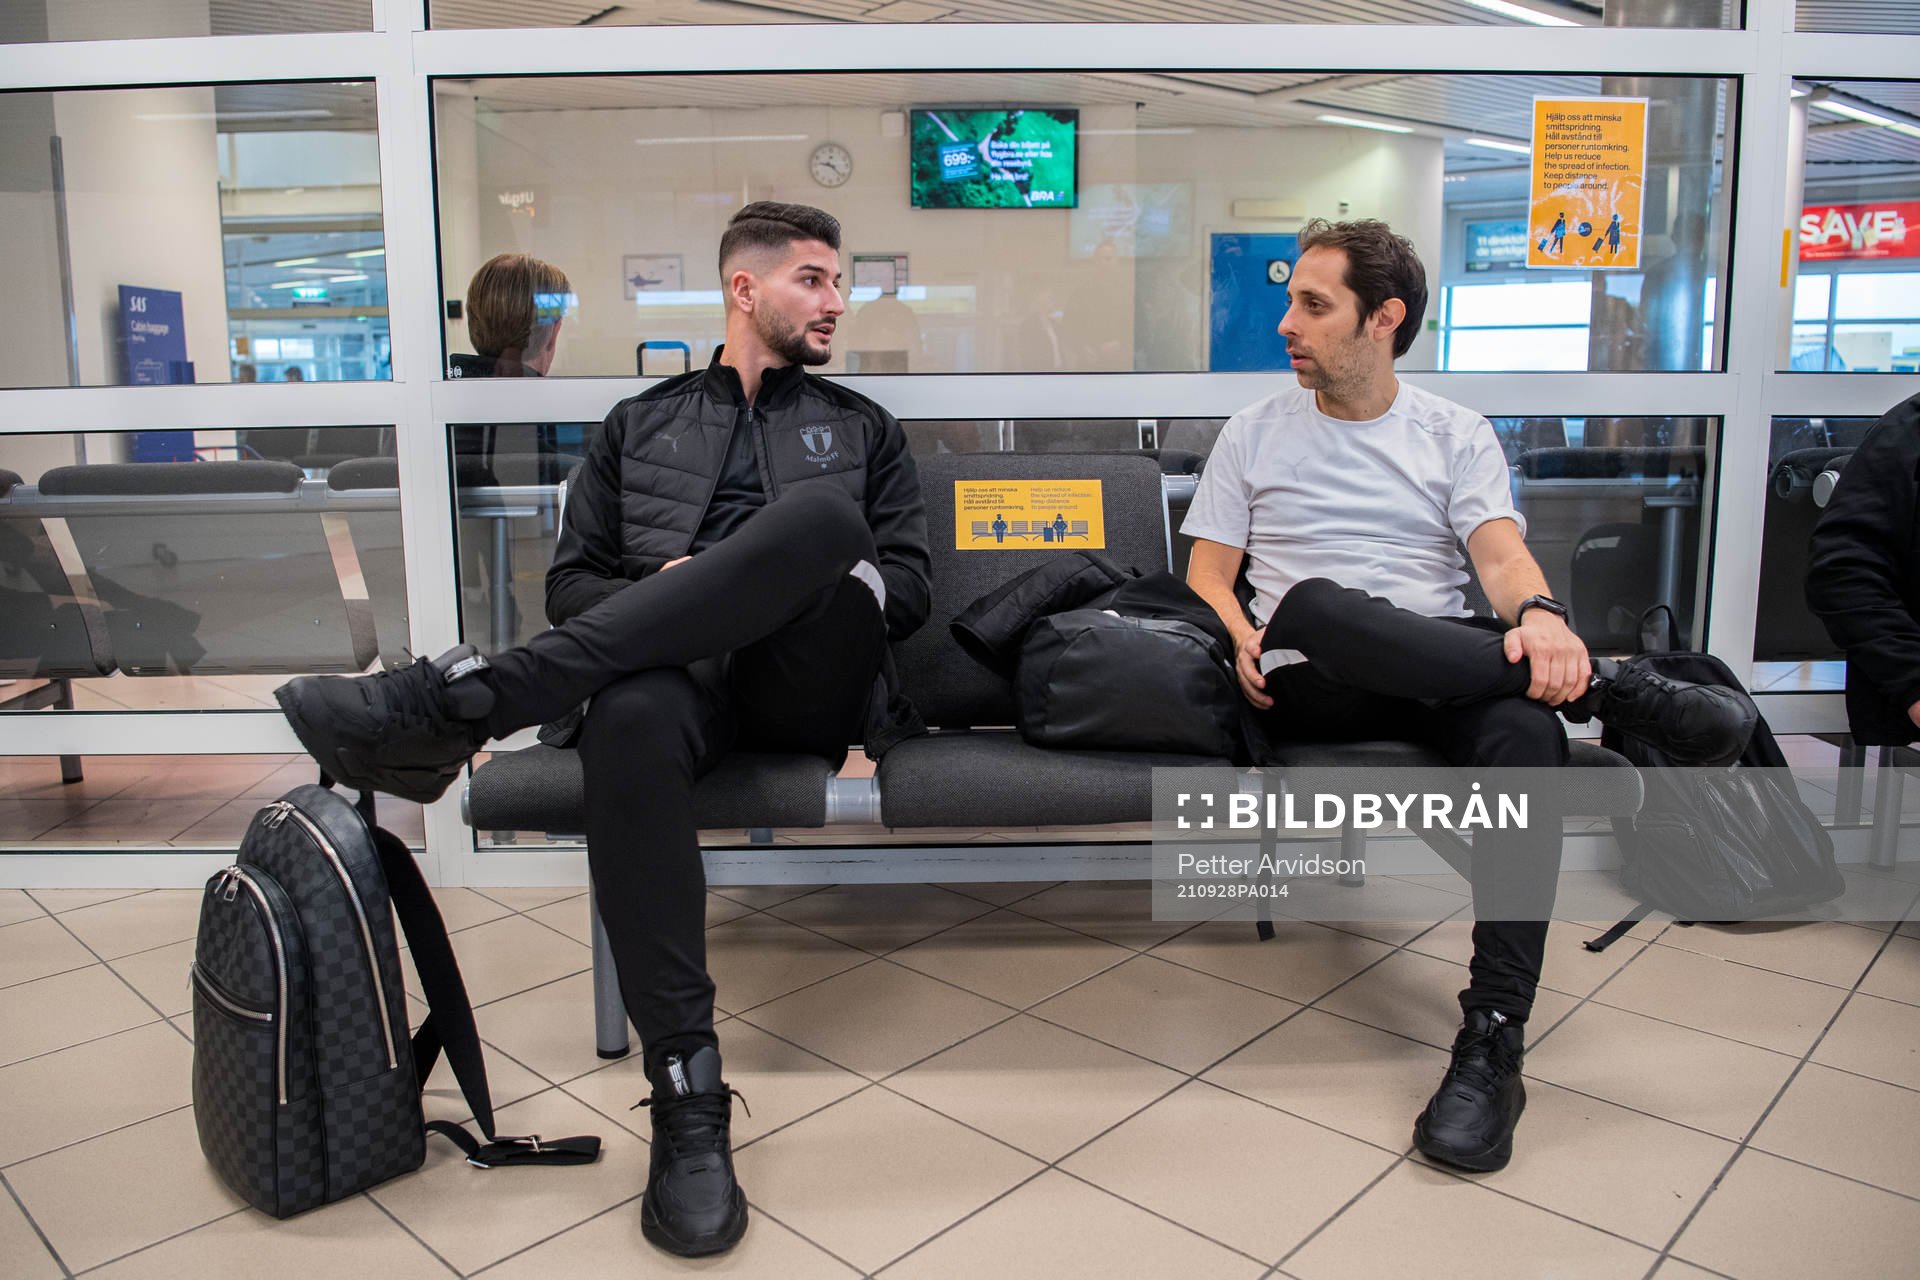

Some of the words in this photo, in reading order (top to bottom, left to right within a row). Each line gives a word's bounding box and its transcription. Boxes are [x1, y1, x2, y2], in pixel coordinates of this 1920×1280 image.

[1546, 113, 1566, 122] Hjälp
[1594, 114, 1622, 122] minska
[1546, 124, 1602, 132] smittspridning.
[1560, 132, 1592, 140] avstånd
[1581, 144, 1630, 152] runtomkring.
[1558, 162, 1585, 170] spread
[1544, 172, 1564, 180] Keep
[1031, 190, 1054, 201] BRA
[1799, 210, 1898, 248] SAVE
[130, 296, 146, 312] SAS
